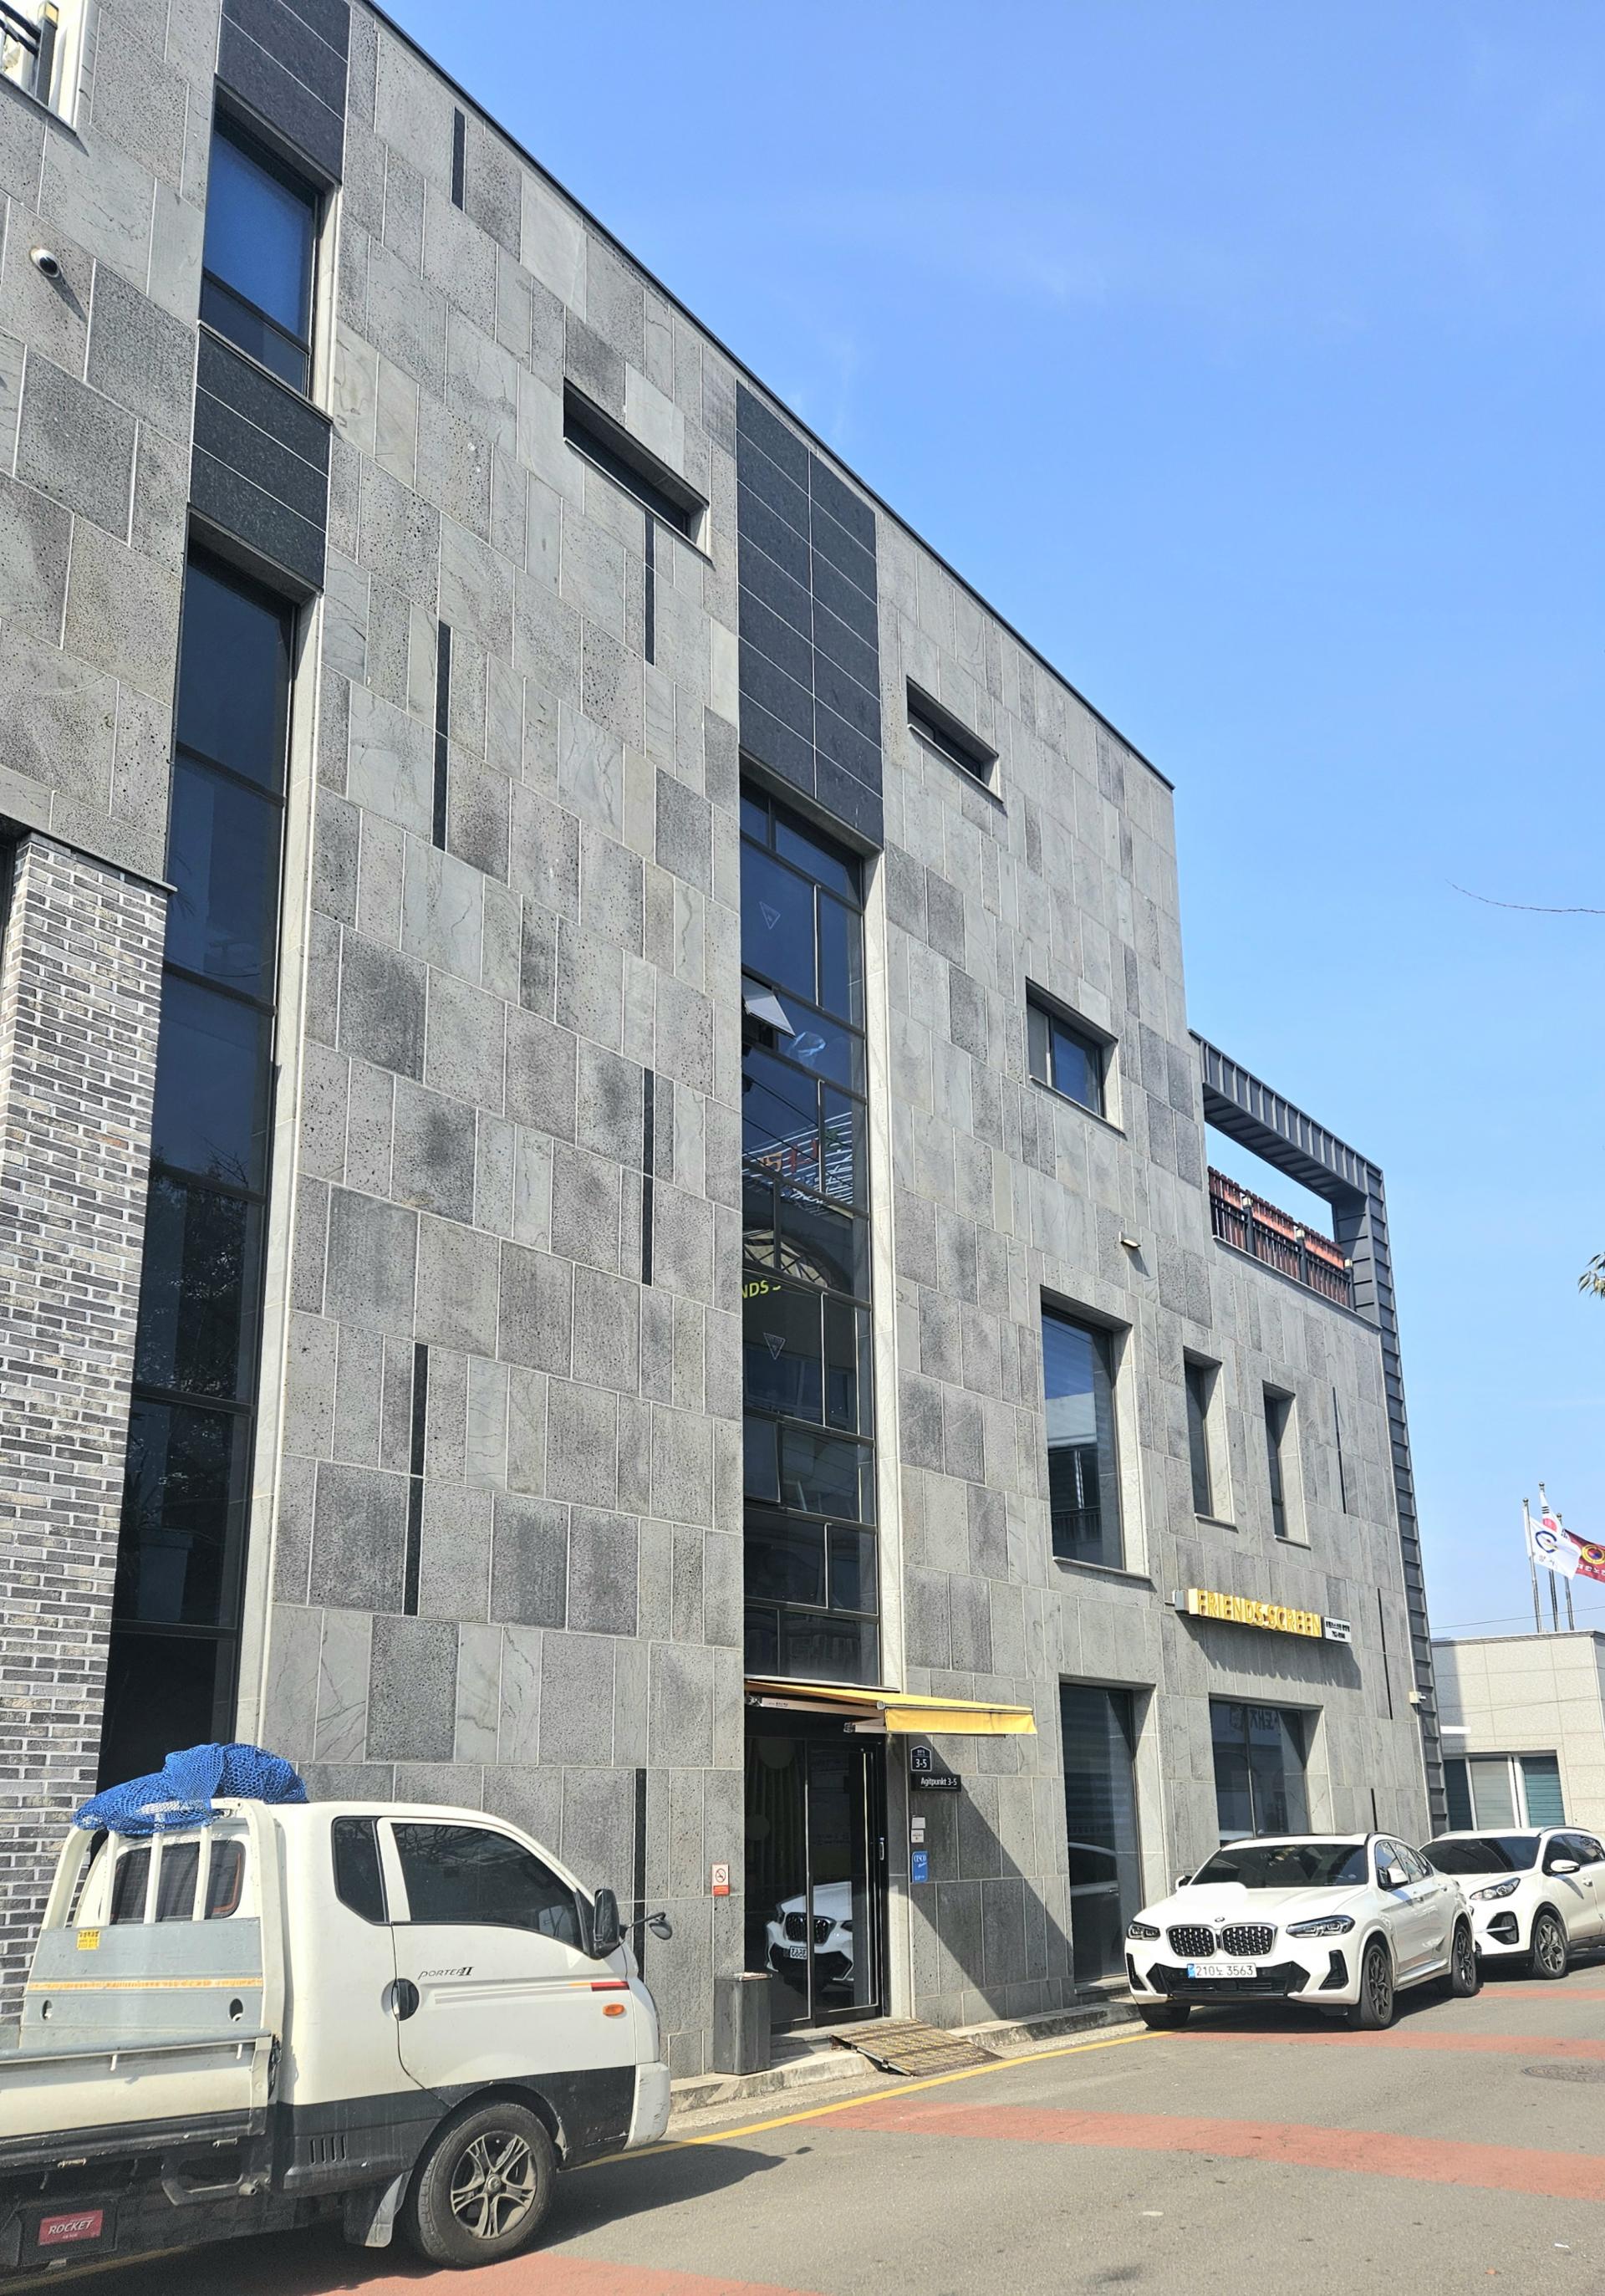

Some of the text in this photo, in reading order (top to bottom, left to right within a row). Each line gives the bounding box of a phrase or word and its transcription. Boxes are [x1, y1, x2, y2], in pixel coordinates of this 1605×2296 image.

[1266, 1604, 1322, 1637] SCREEN
[915, 1758, 927, 1768] 3-5
[947, 1778, 957, 1786] 3-5
[1226, 1965, 1253, 1976] 3563
[48, 2219, 94, 2235] ROCKET
